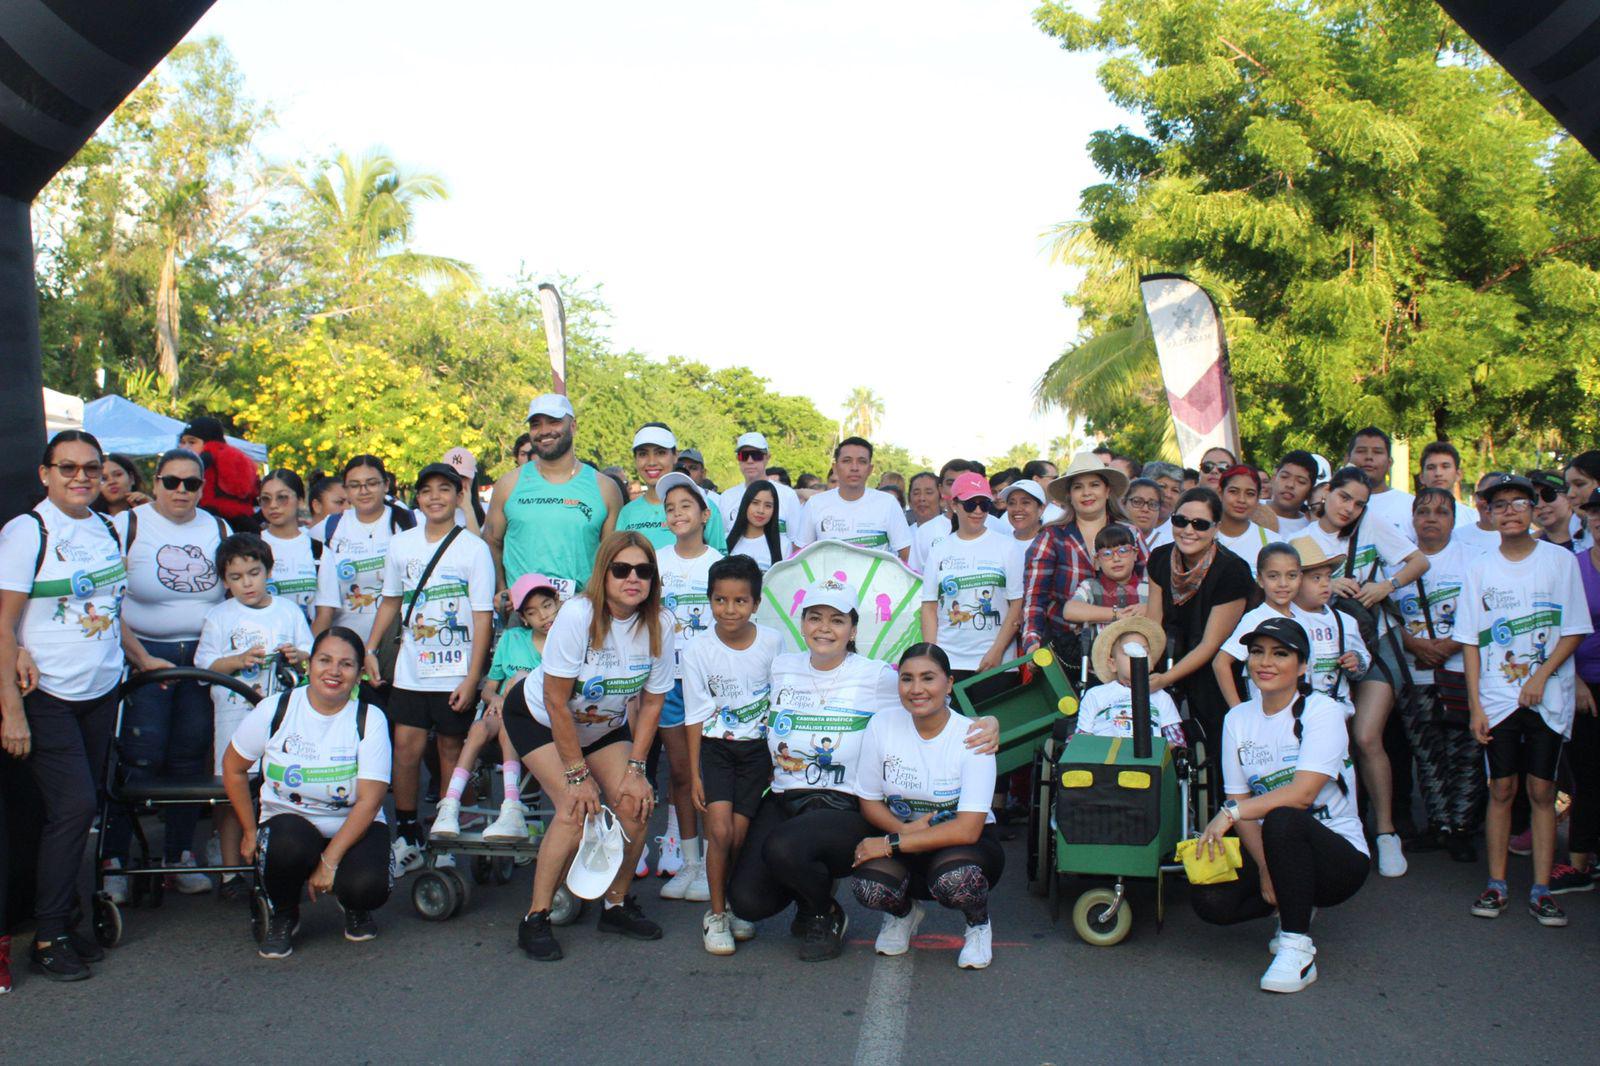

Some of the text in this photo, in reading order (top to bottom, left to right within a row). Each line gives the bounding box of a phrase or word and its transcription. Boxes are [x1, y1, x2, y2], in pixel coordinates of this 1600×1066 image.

[1491, 617, 1512, 646] 6
[582, 675, 604, 701] 6
[794, 723, 823, 731] PARÁLISIS
[284, 764, 302, 788] 6
